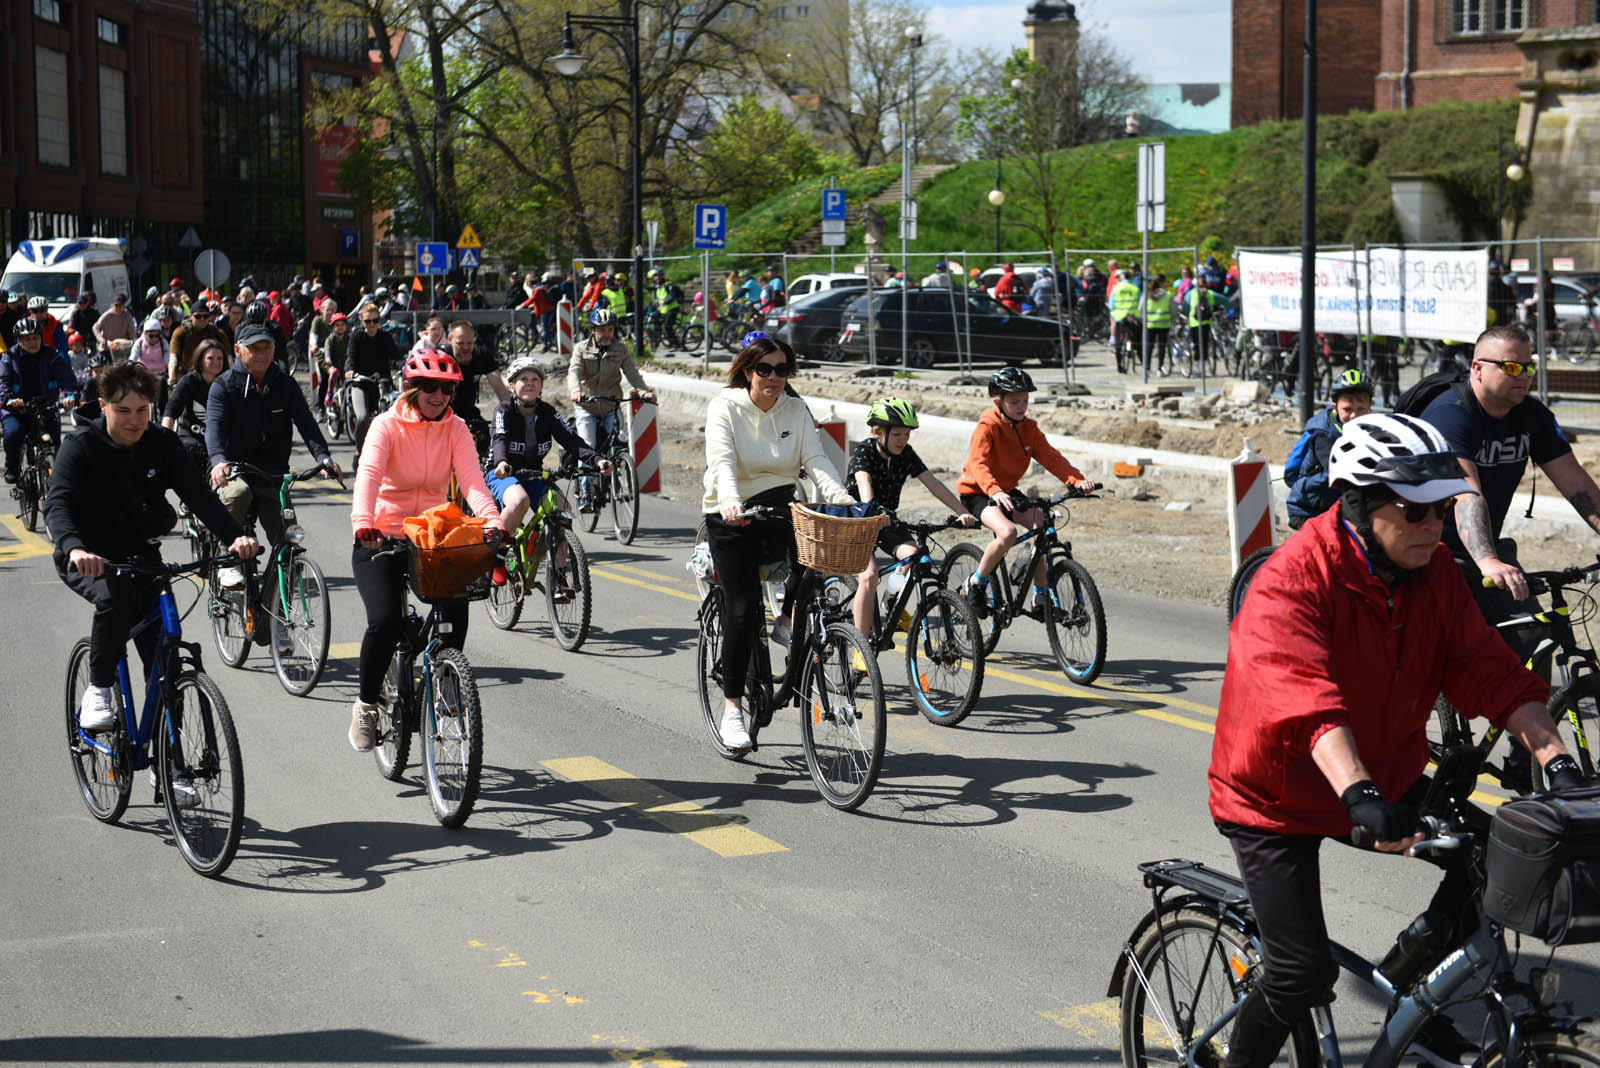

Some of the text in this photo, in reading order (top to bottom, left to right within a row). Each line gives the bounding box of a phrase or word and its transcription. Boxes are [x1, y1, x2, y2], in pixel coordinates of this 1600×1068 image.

[827, 191, 841, 211] P
[702, 208, 720, 236] P
[345, 235, 354, 248] P
[1475, 434, 1530, 464] NASA
